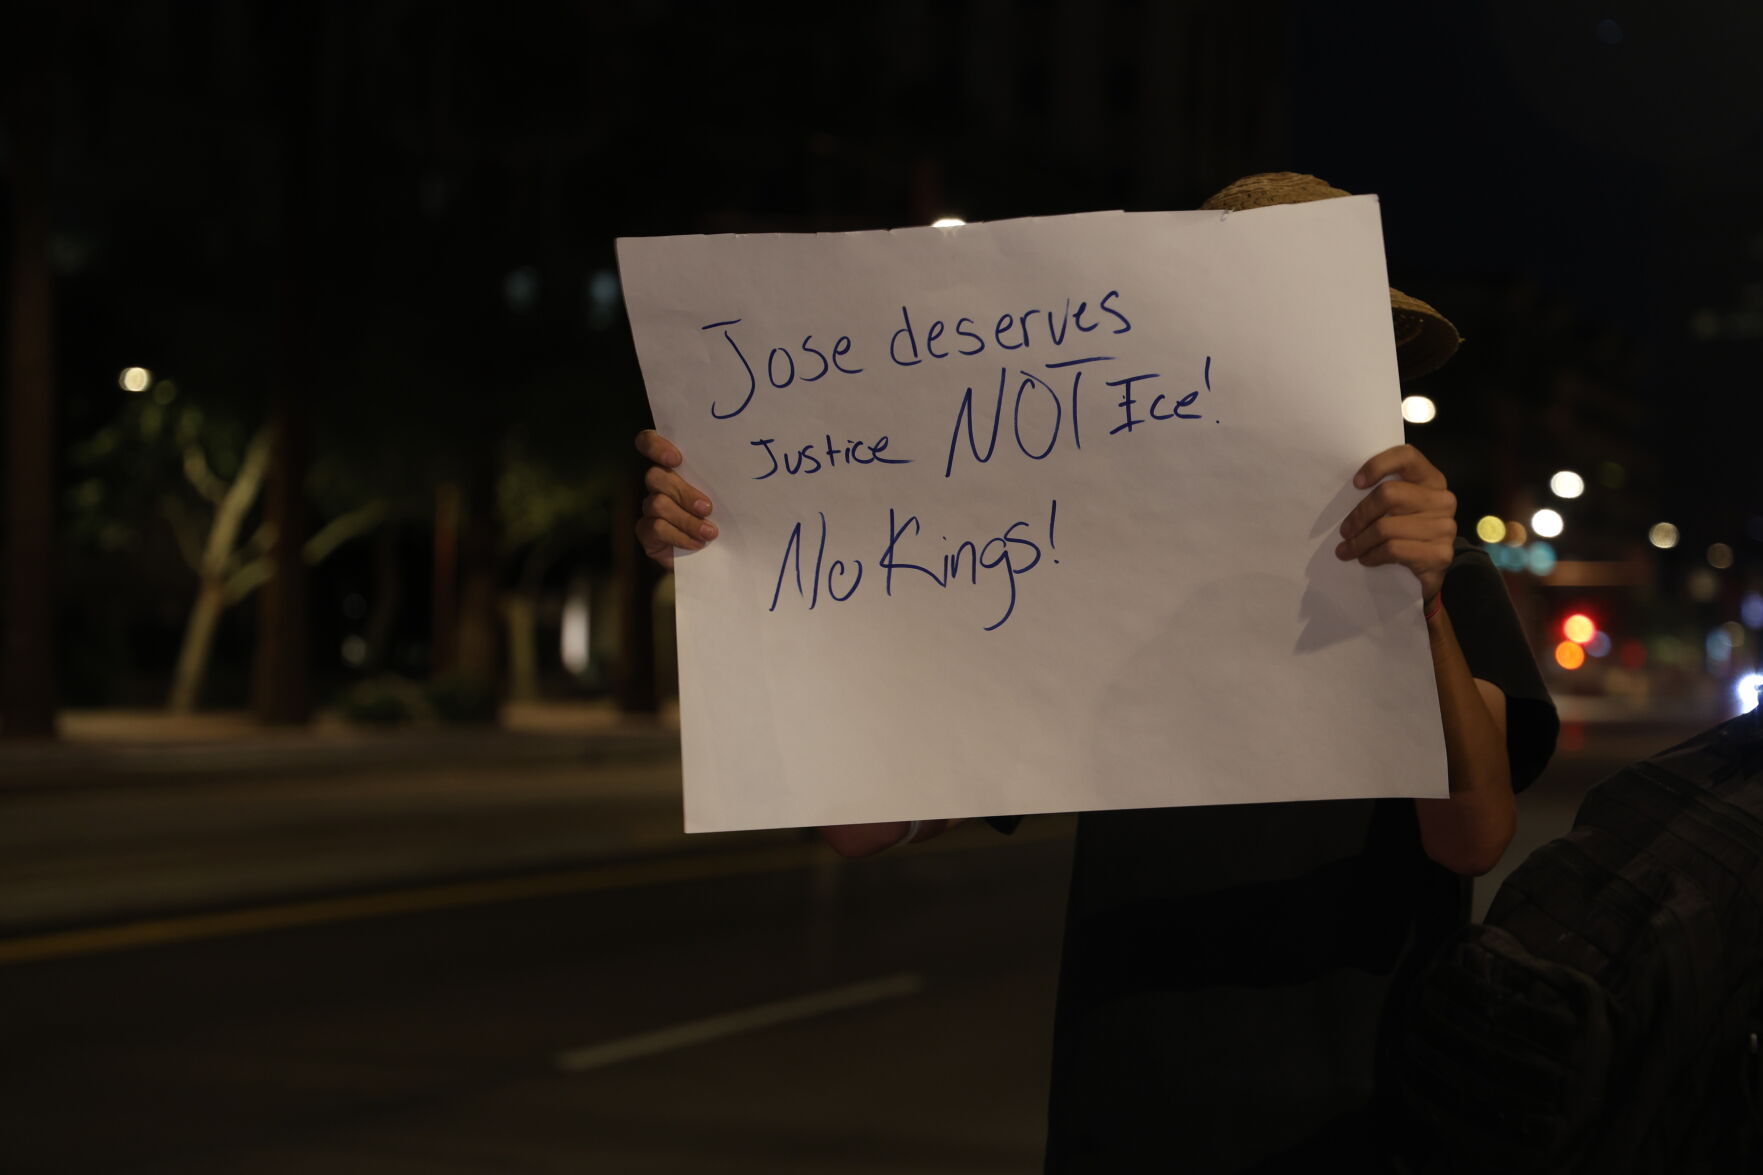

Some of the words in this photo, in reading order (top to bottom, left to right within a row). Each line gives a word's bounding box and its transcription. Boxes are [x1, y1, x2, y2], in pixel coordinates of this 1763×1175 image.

[701, 319, 863, 420] Jose
[890, 290, 1132, 366] deserves
[750, 434, 914, 480] Justice
[945, 356, 1117, 478] NOT
[1105, 356, 1221, 435] Ice!
[769, 511, 863, 612] No
[879, 499, 1060, 631] Kings!
